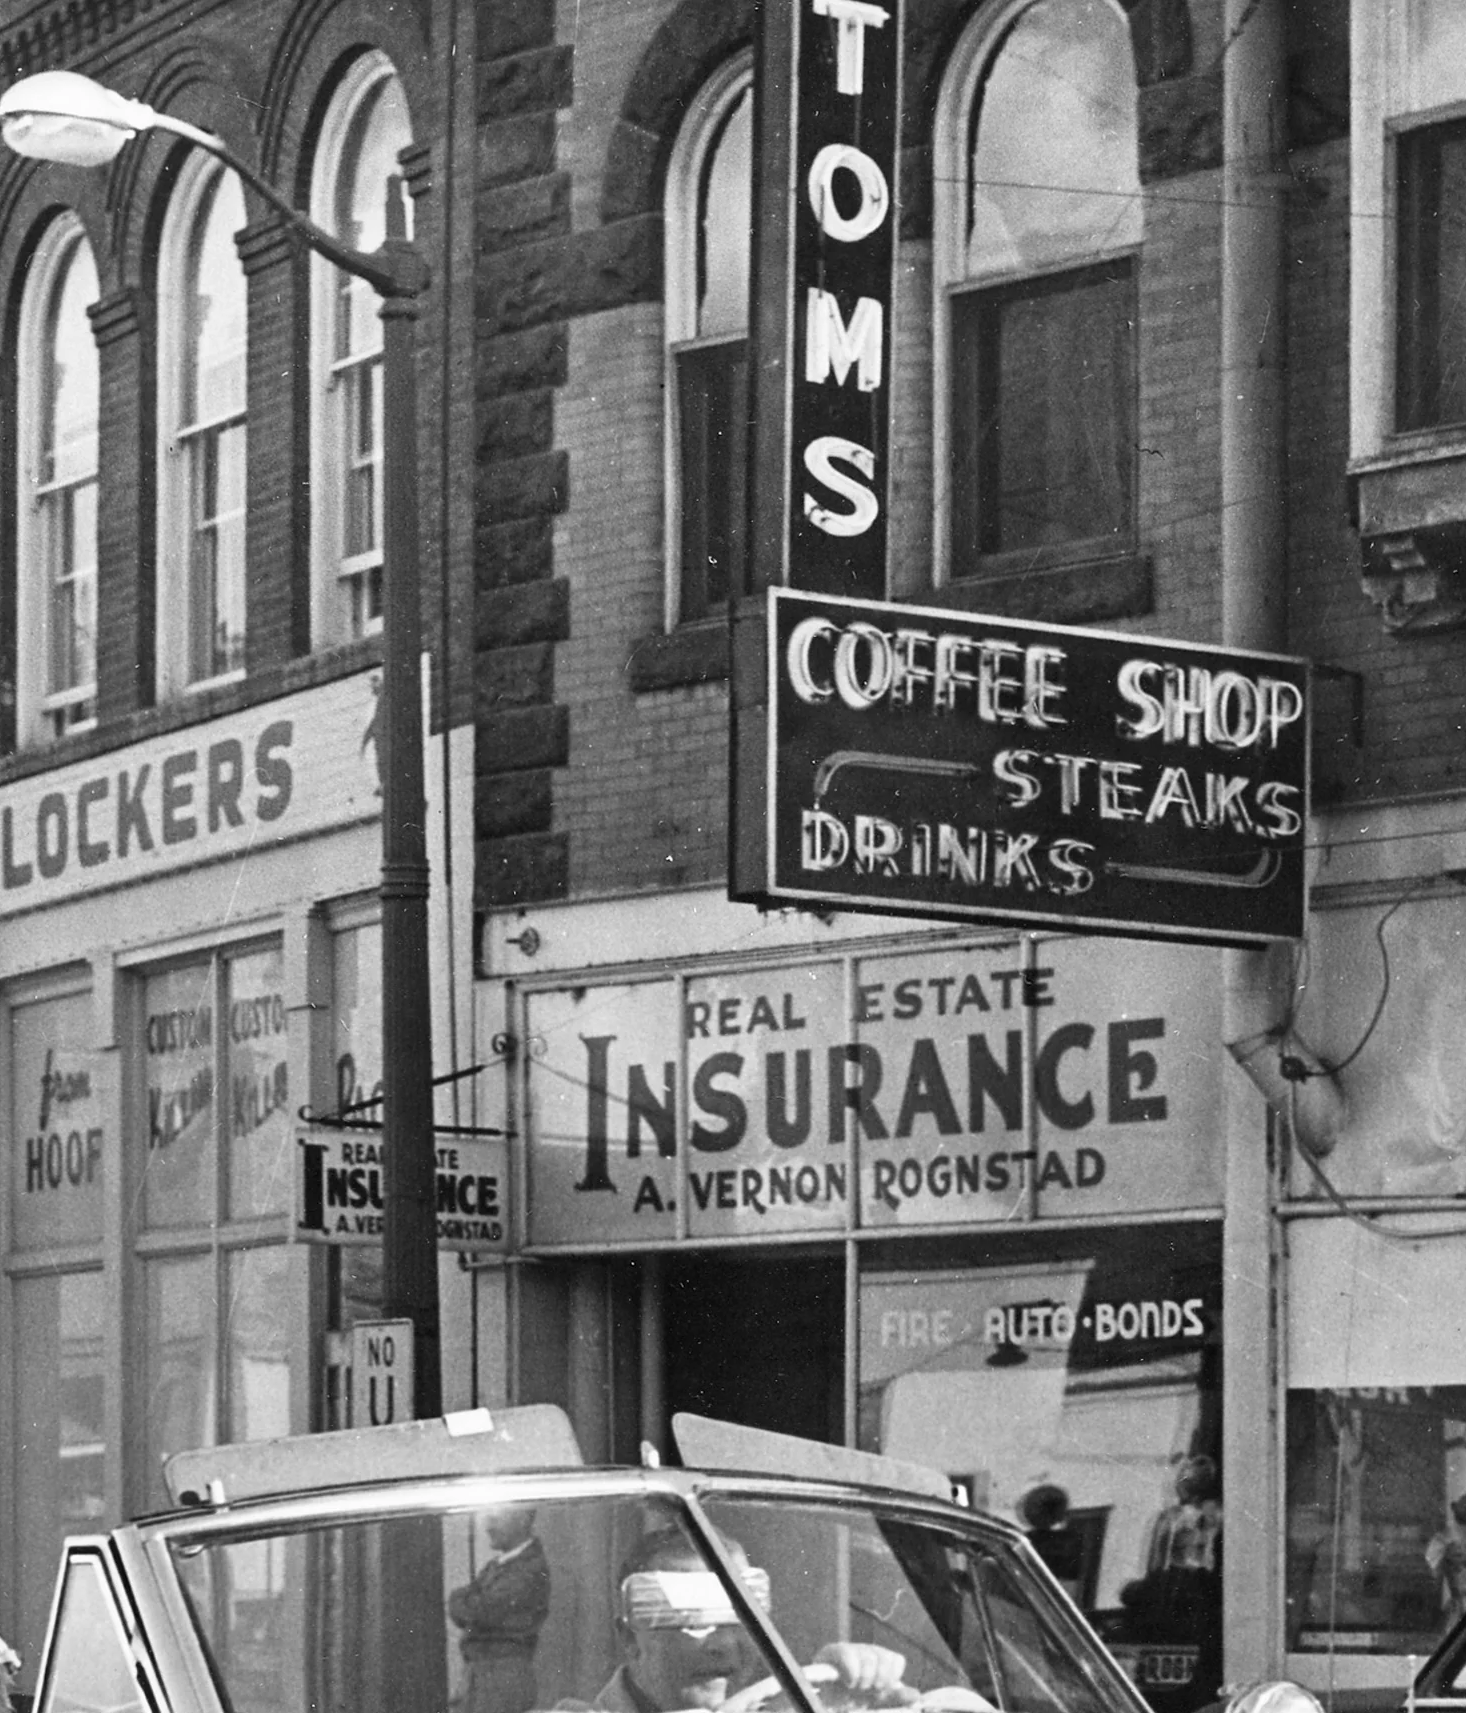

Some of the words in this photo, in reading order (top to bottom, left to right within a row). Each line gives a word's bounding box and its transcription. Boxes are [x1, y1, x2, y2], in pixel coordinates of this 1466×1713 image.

[804, 0, 890, 537] TOMS
[787, 617, 1068, 729] COFFEE
[1116, 660, 1304, 750] SHOP
[2, 719, 295, 891] LOCKERS
[992, 749, 1303, 838] STEAKS
[800, 808, 1096, 895] DRINKS
[686, 993, 806, 1039] REAL
[851, 967, 1056, 1023] ESTATE
[574, 1017, 1170, 1194] INSURANCE
[27, 1127, 103, 1194] HOOF
[297, 1138, 500, 1236] INSUNCE
[341, 1142, 384, 1167] REA
[633, 1176, 676, 1213] A.
[689, 1161, 846, 1214] VERNON
[874, 1147, 1107, 1210] ROGNSTAD
[435, 1219, 504, 1242] OGNSTAD
[368, 1335, 395, 1368] NO
[883, 1309, 954, 1346] FIRE
[986, 1306, 1076, 1345] AUTO
[1095, 1298, 1204, 1342] BONDS
[369, 1375, 395, 1428] U
